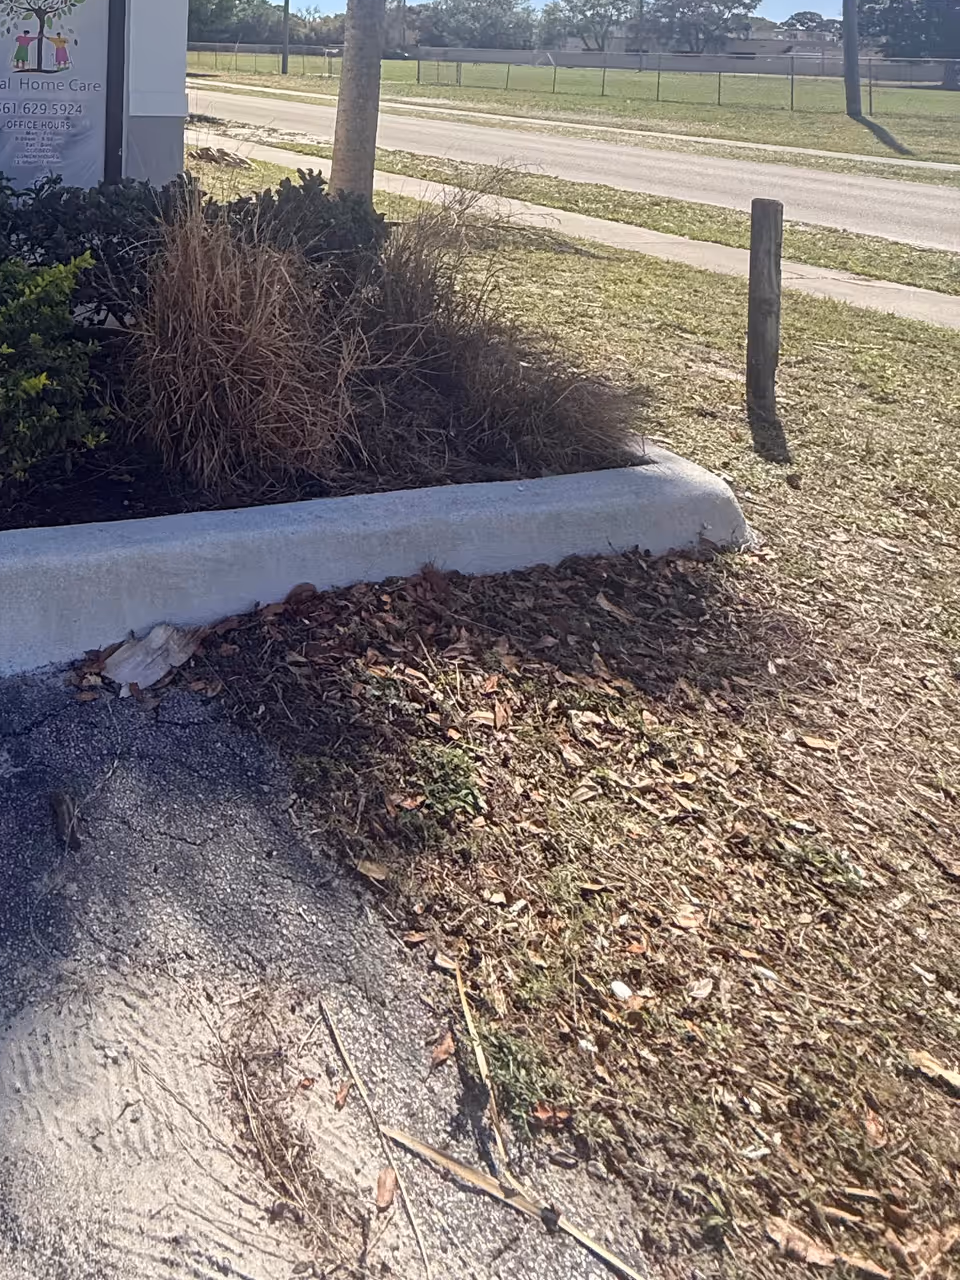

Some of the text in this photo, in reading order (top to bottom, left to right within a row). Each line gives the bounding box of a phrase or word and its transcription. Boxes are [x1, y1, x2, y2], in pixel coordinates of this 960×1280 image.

[19, 77, 65, 91] Home
[68, 78, 102, 92] Care
[6, 120, 71, 130] OFFICE HOURS
